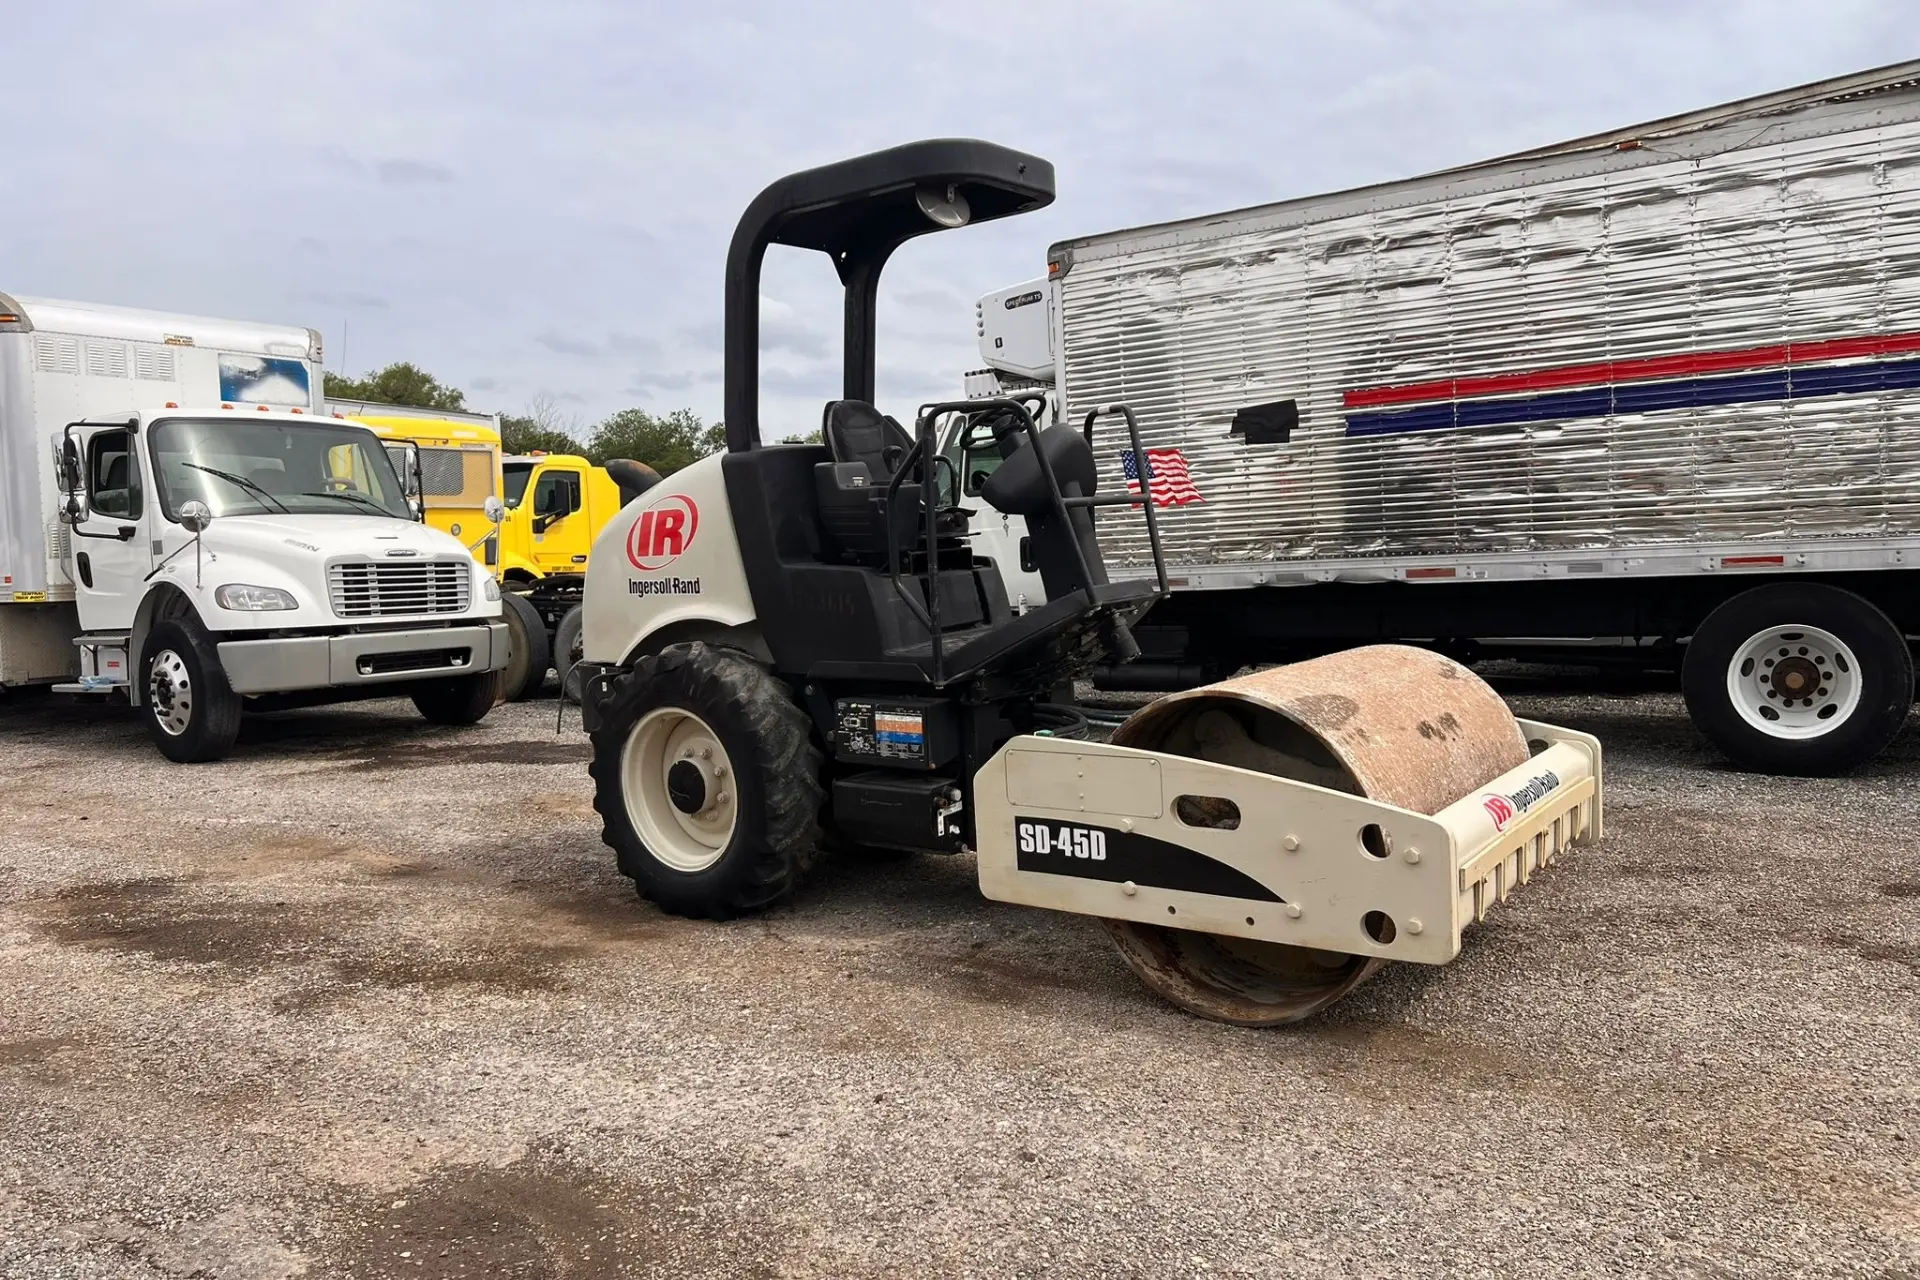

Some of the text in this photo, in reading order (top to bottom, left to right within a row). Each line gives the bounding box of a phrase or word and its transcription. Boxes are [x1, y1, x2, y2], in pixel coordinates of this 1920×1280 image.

[637, 508, 686, 557] IR
[1483, 797, 1512, 825] IR
[1019, 823, 1107, 861] SD-45D
